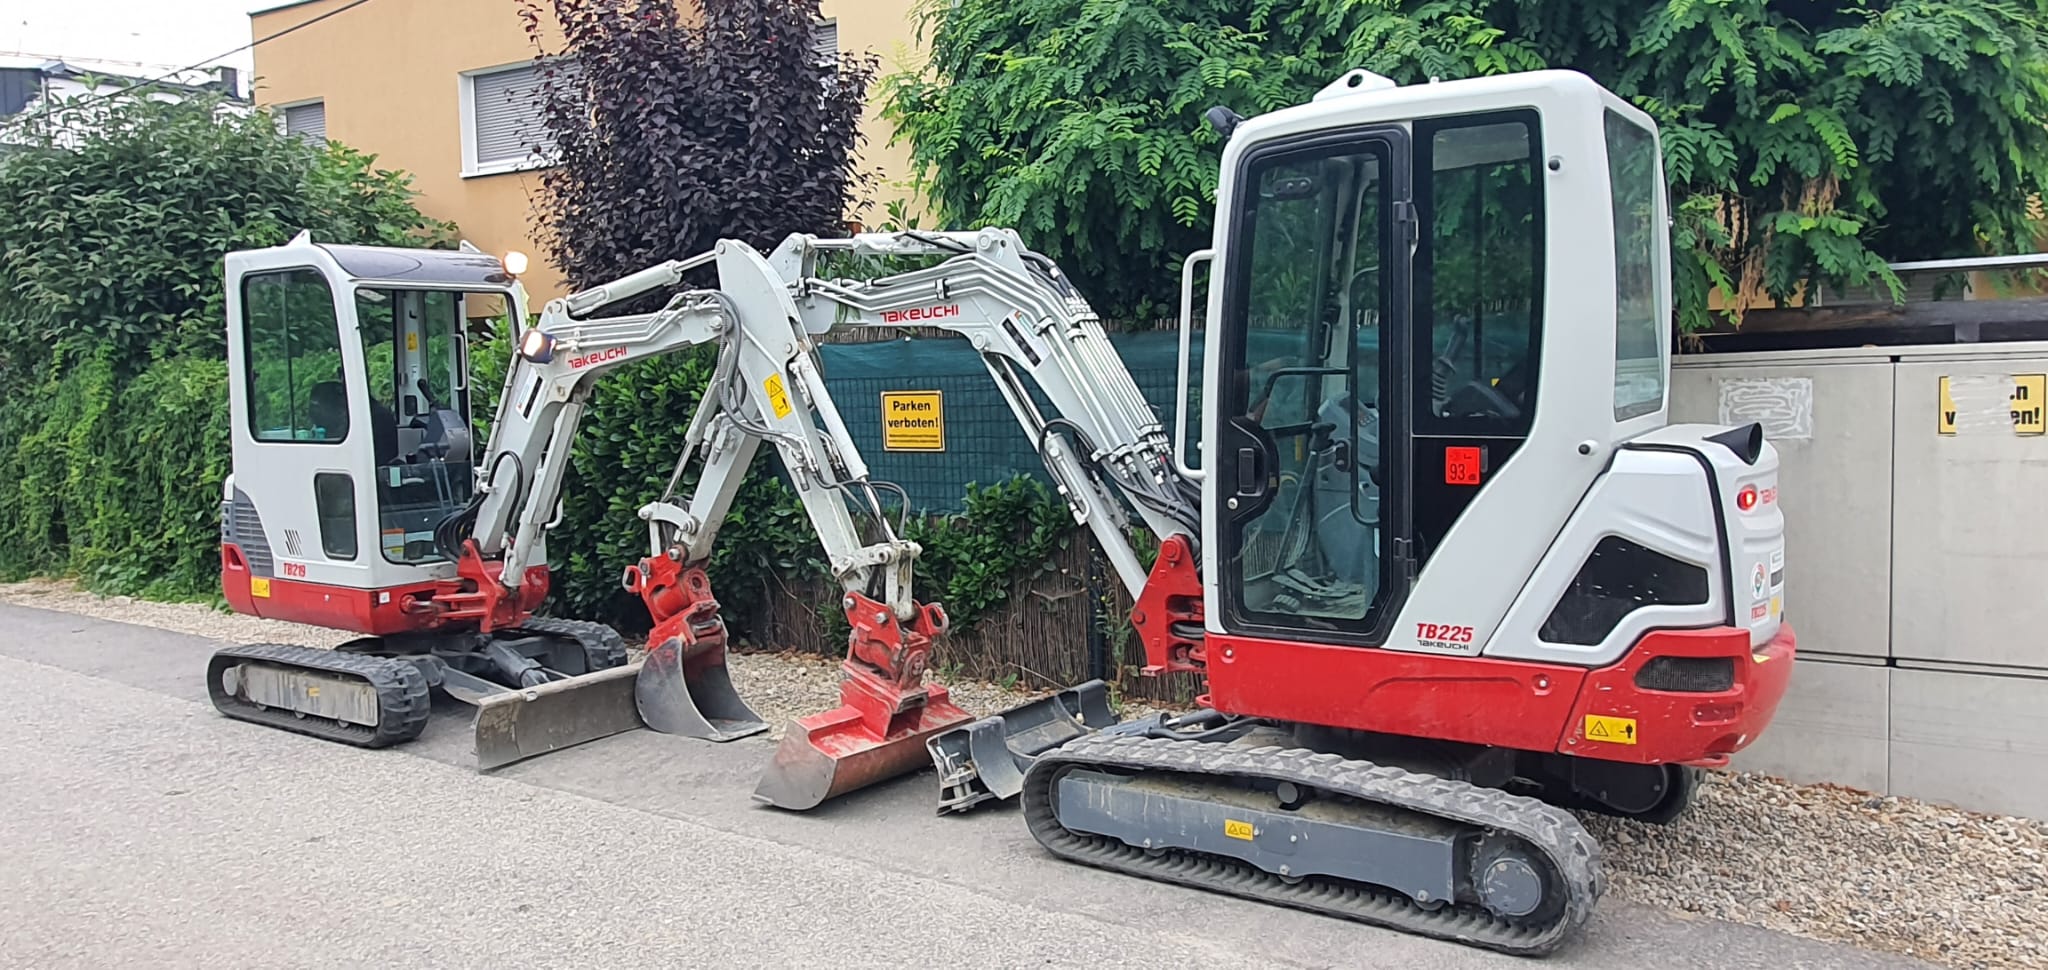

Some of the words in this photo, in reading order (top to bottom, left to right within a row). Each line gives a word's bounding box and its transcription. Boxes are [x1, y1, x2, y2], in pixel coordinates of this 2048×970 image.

[892, 400, 931, 411] Parken
[888, 417, 938, 428] verboten!
[1450, 463, 1465, 481] 93
[283, 562, 306, 577] TB219
[1417, 623, 1473, 642] TB225
